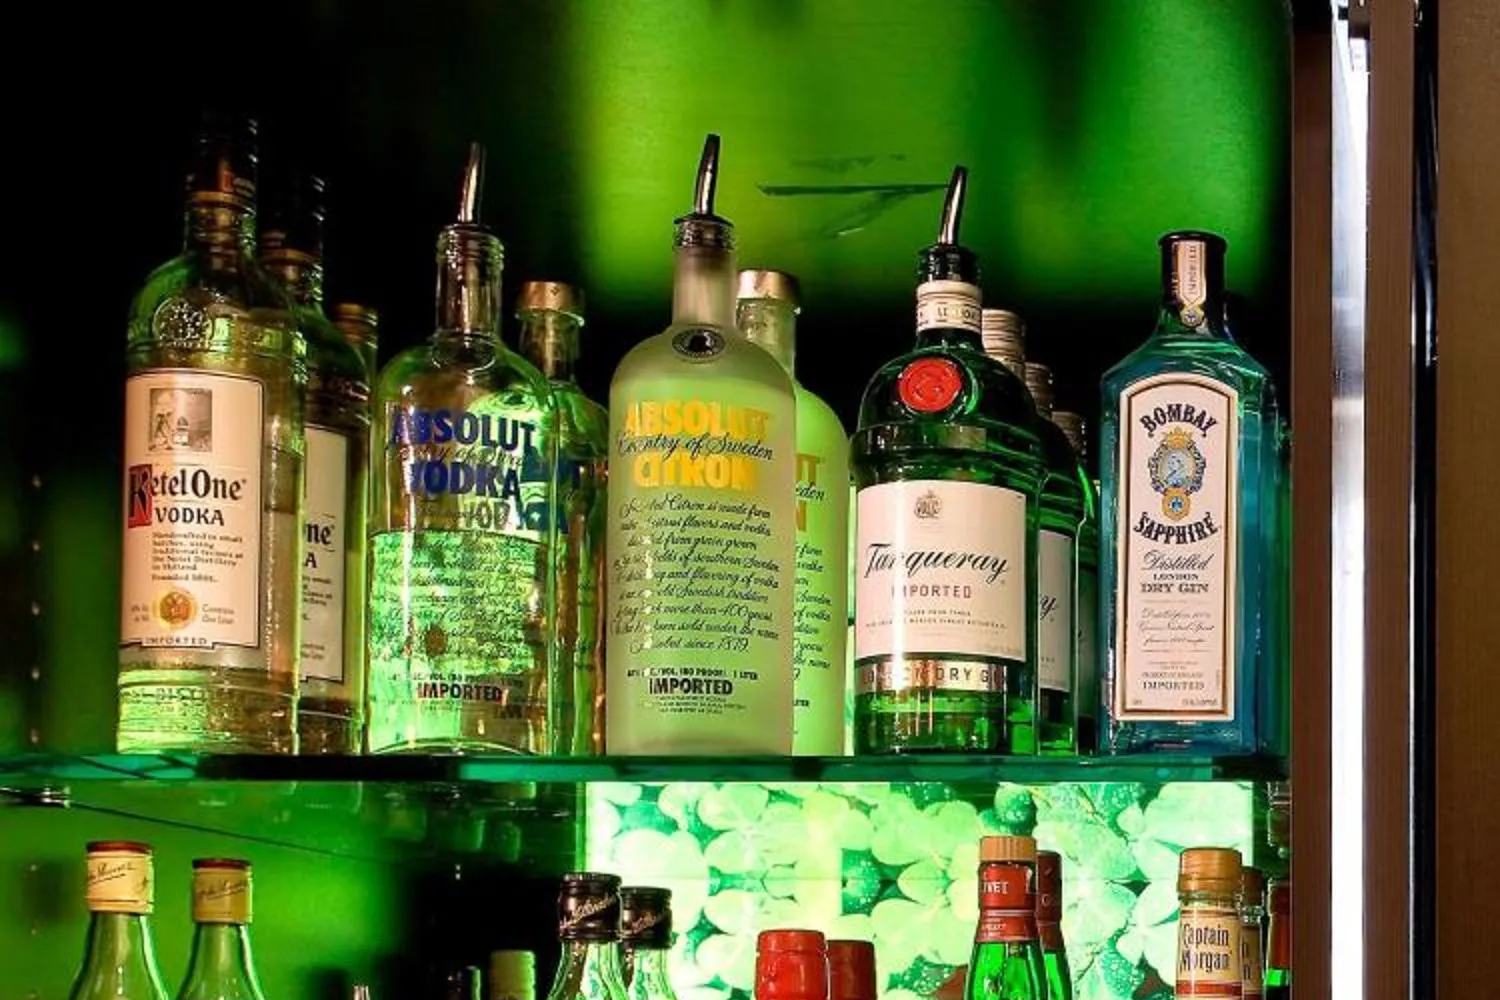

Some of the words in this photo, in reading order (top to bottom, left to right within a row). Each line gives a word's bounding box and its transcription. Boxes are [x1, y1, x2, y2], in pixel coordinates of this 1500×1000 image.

[393, 410, 536, 451] ABSOLUT
[624, 400, 770, 441] ABSOLUT
[1140, 402, 1218, 438] BOMBAY
[706, 431, 775, 461] Sweden
[634, 452, 757, 489] CITRON
[129, 465, 187, 525] Ketel
[191, 468, 242, 500] One
[155, 508, 225, 526] VODKA
[1133, 511, 1220, 545] SAPPHIRE
[304, 523, 331, 545] ne
[1141, 549, 1214, 571] Distilled
[892, 585, 972, 599] IPORTED
[1140, 583, 1175, 594] DRY
[1178, 583, 1209, 594] GIN
[935, 667, 972, 682] DRY
[1142, 680, 1205, 692] IMPORTED
[416, 682, 503, 703] IMPORTED
[649, 678, 733, 695] IMPORTED
[1182, 922, 1229, 949] Captain
[1180, 950, 1232, 974] Morgan
